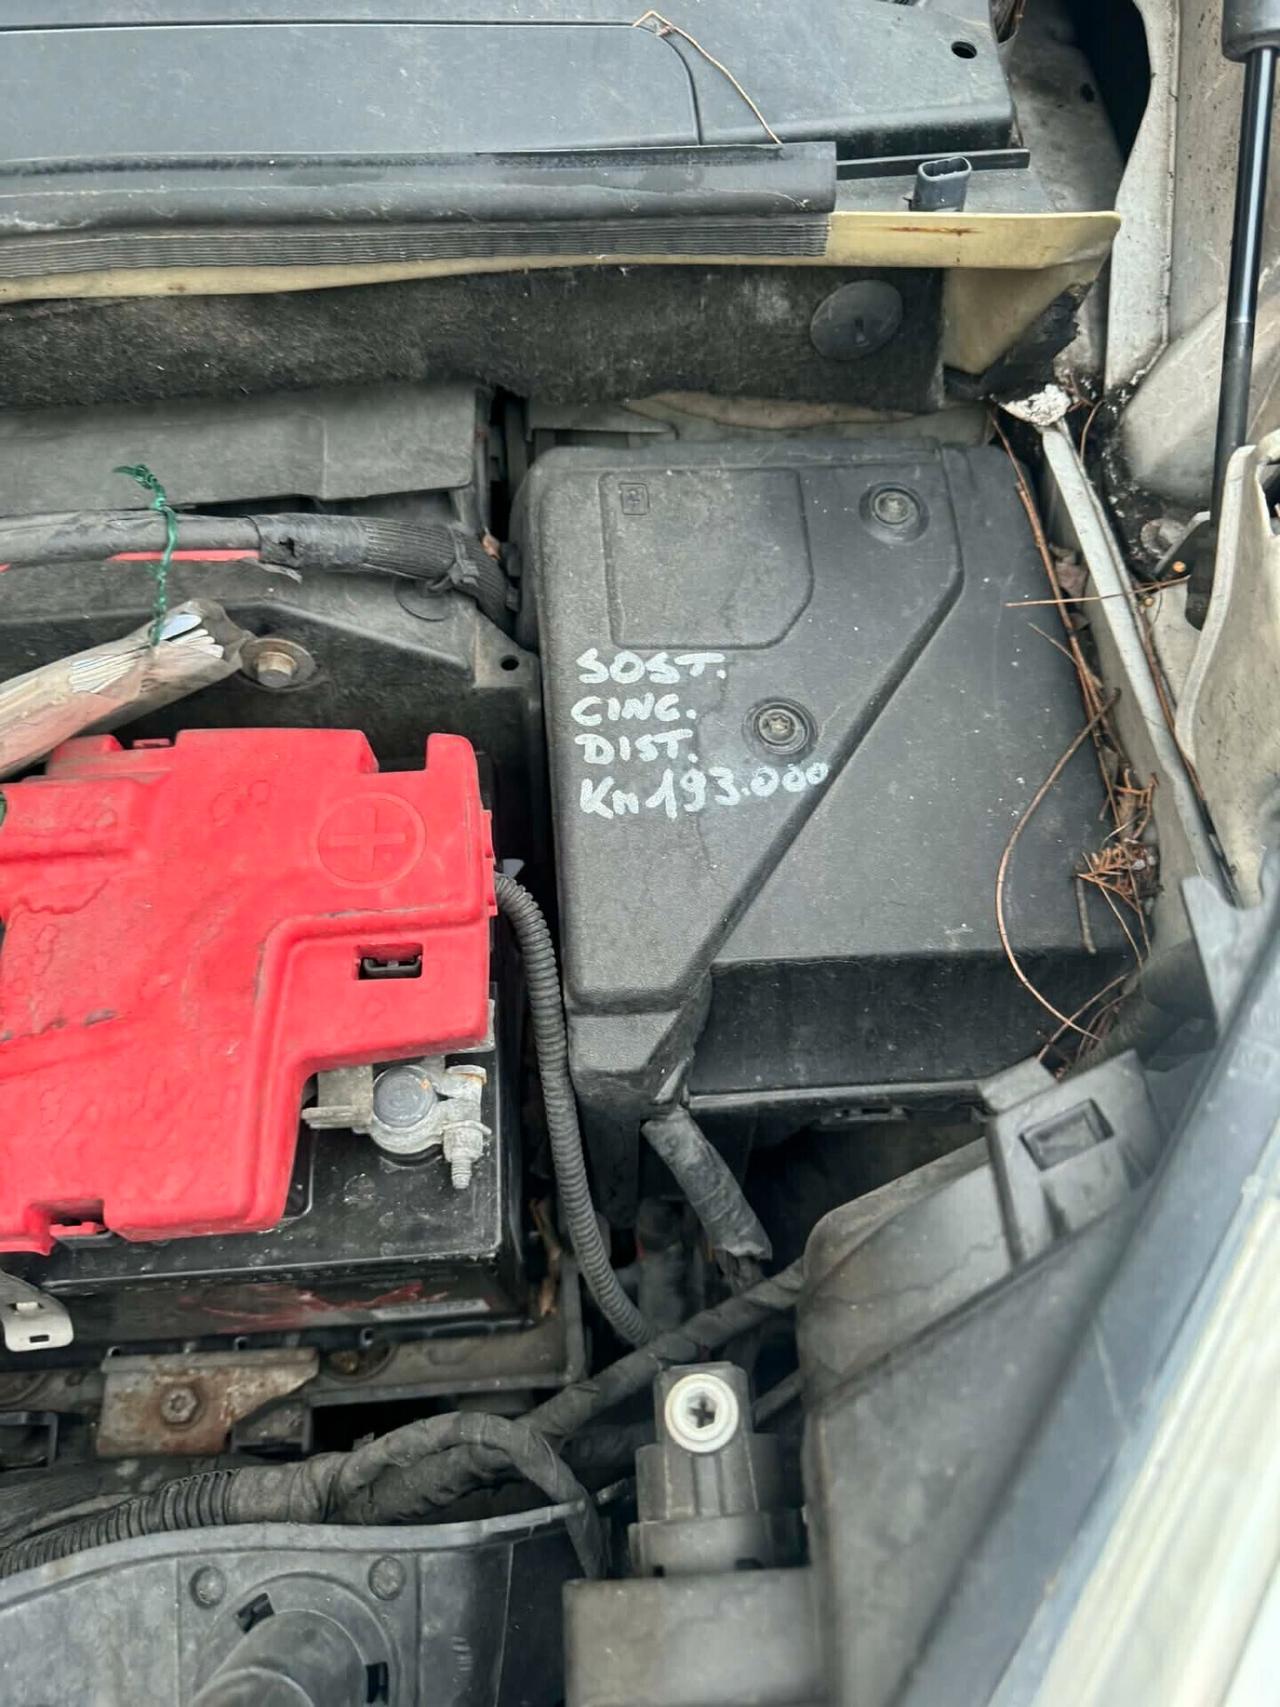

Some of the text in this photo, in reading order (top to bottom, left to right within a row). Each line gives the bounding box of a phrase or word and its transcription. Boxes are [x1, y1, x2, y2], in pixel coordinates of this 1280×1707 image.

[576, 648, 726, 684] SOST.
[571, 692, 697, 726] CING.
[575, 728, 698, 765] DIST.
[645, 763, 829, 820] 193.000
